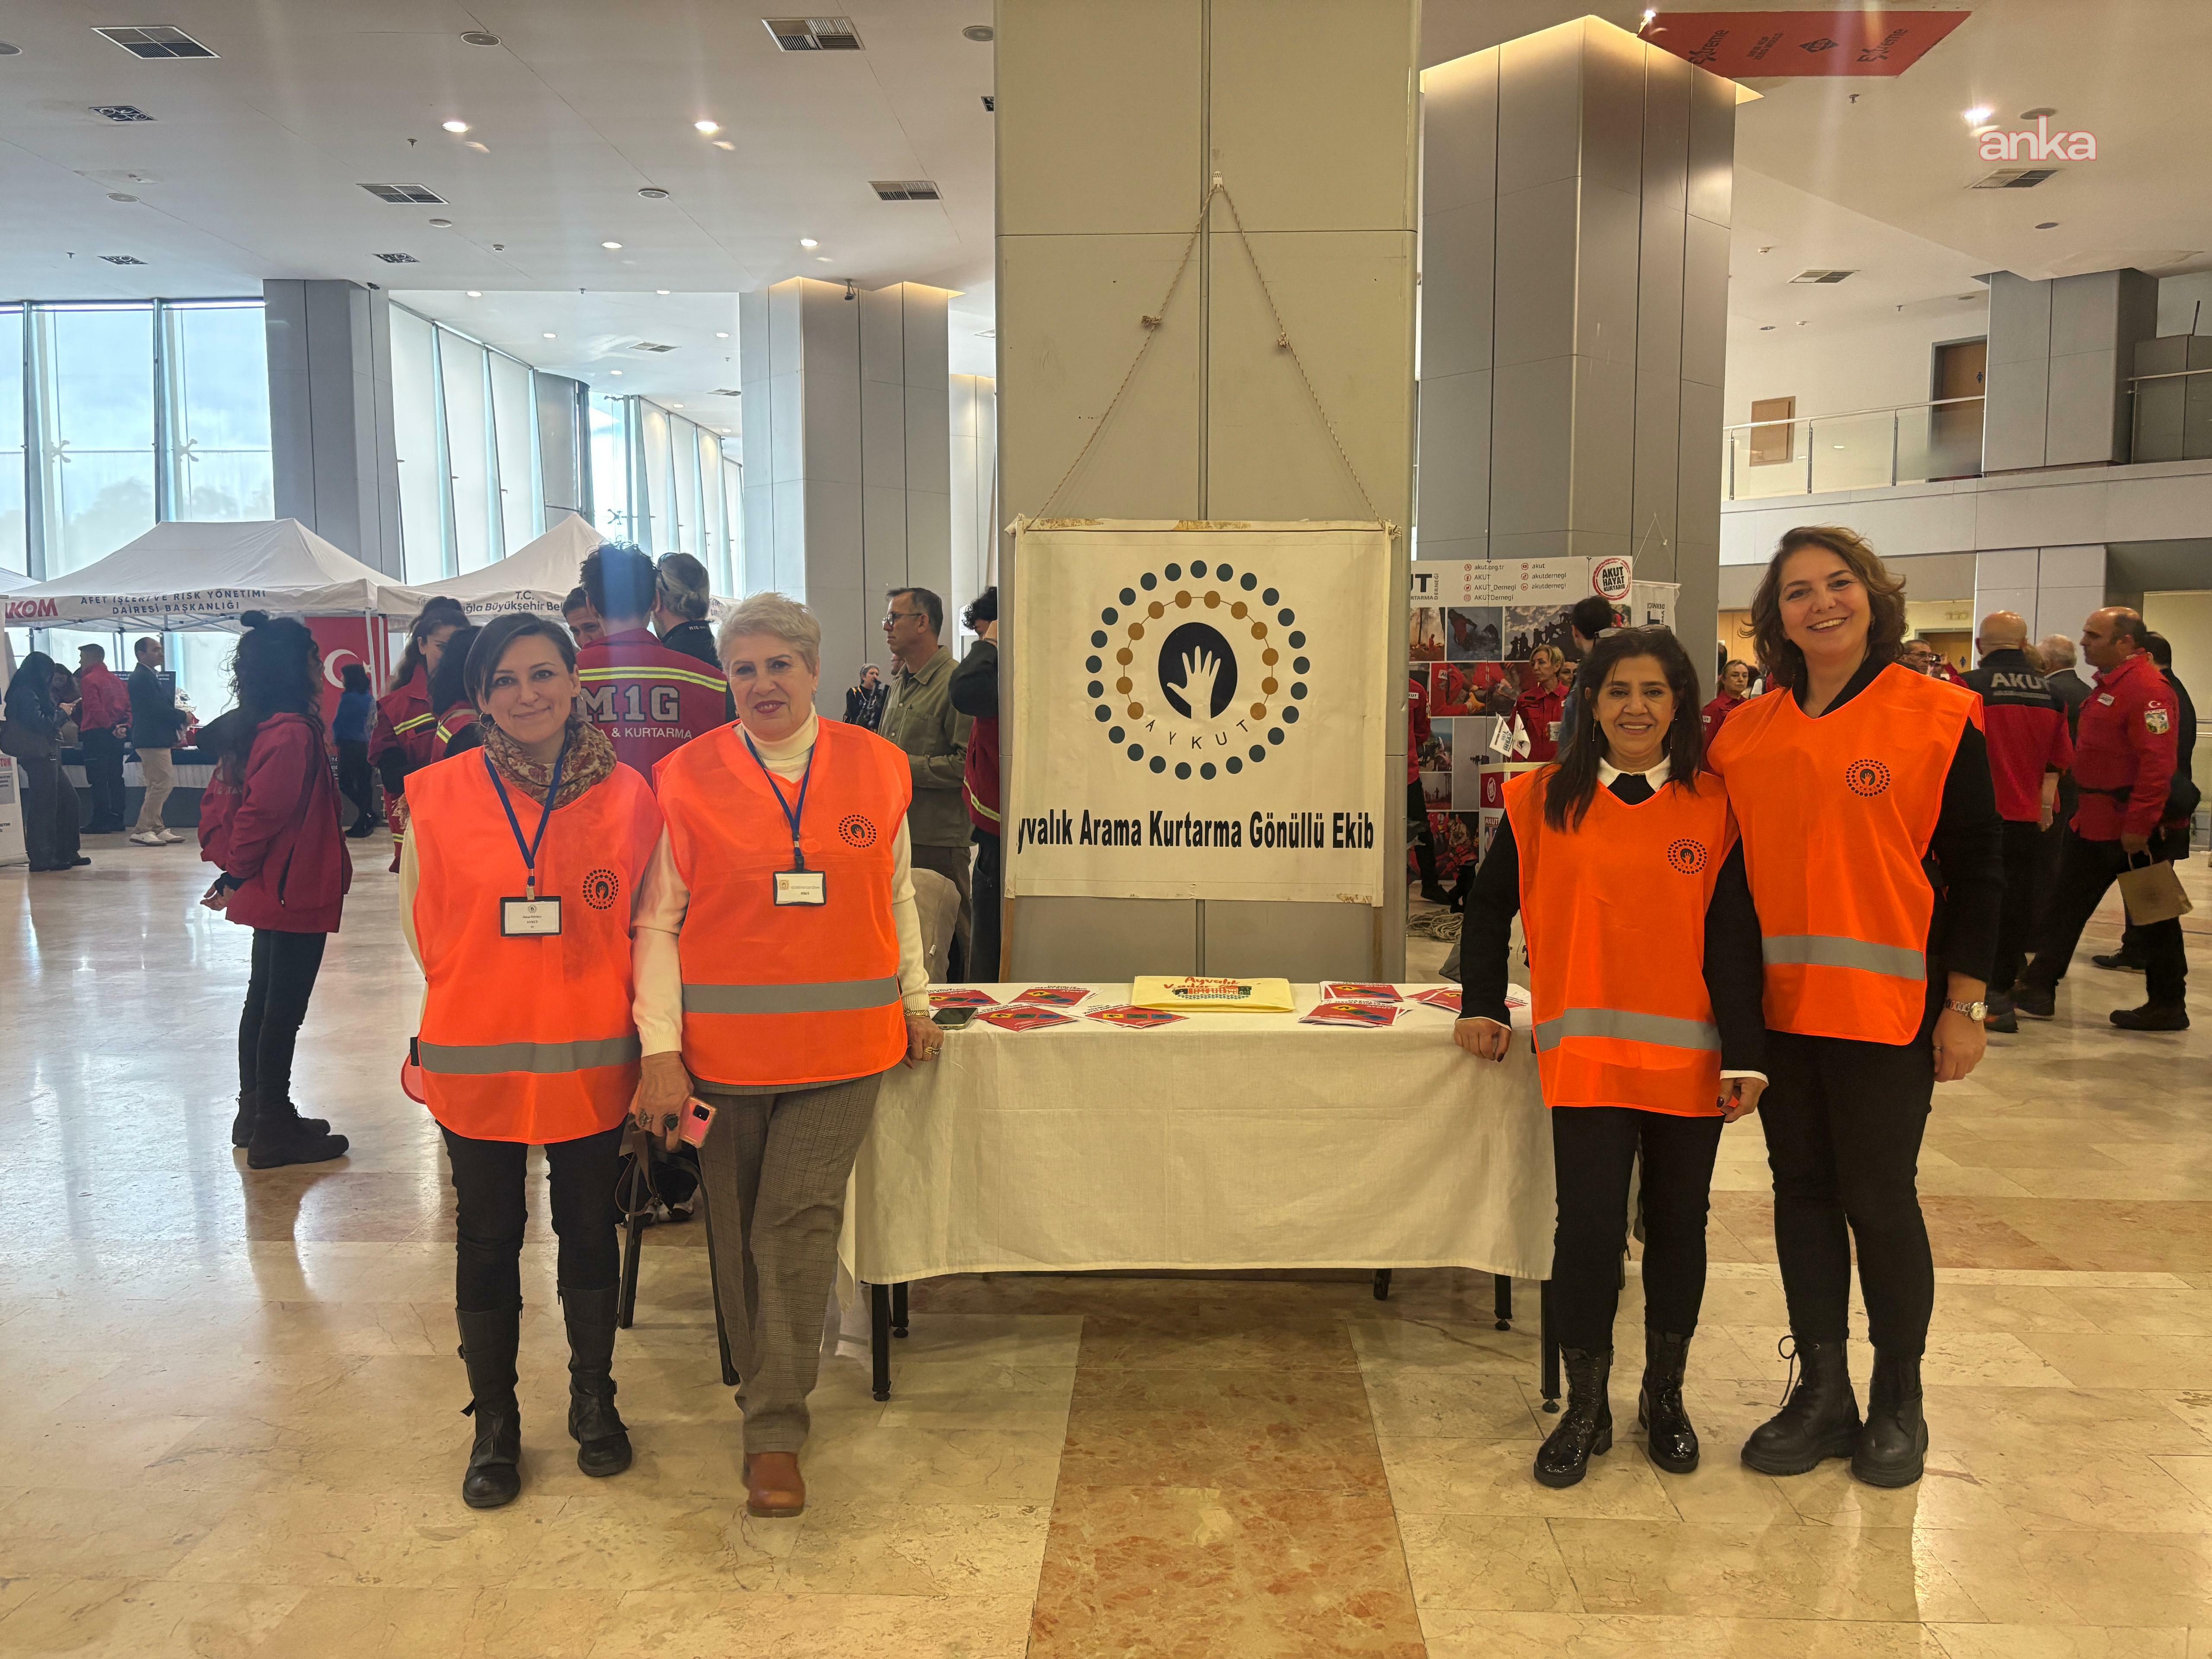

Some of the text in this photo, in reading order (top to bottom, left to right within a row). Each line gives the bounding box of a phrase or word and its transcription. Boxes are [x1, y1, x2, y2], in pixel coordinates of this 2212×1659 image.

[1602, 566, 1623, 578] AKUT
[1603, 575, 1624, 586] HAYAT
[516, 591, 534, 600] T.C.
[113, 600, 239, 614] DAİRESİ BAŞKANLIĞI
[485, 601, 544, 612] Büyükşehir
[1991, 672, 2050, 690] AKUT
[576, 684, 680, 722] M1G
[611, 727, 620, 737] &
[625, 727, 692, 739] KURTARMA
[1145, 719, 1248, 750] AYKUT
[1080, 809, 1141, 846] Arama
[1150, 810, 1242, 848] Kurtarma
[1249, 811, 1324, 849] Gönüllü
[1333, 812, 1373, 849] Ekib
